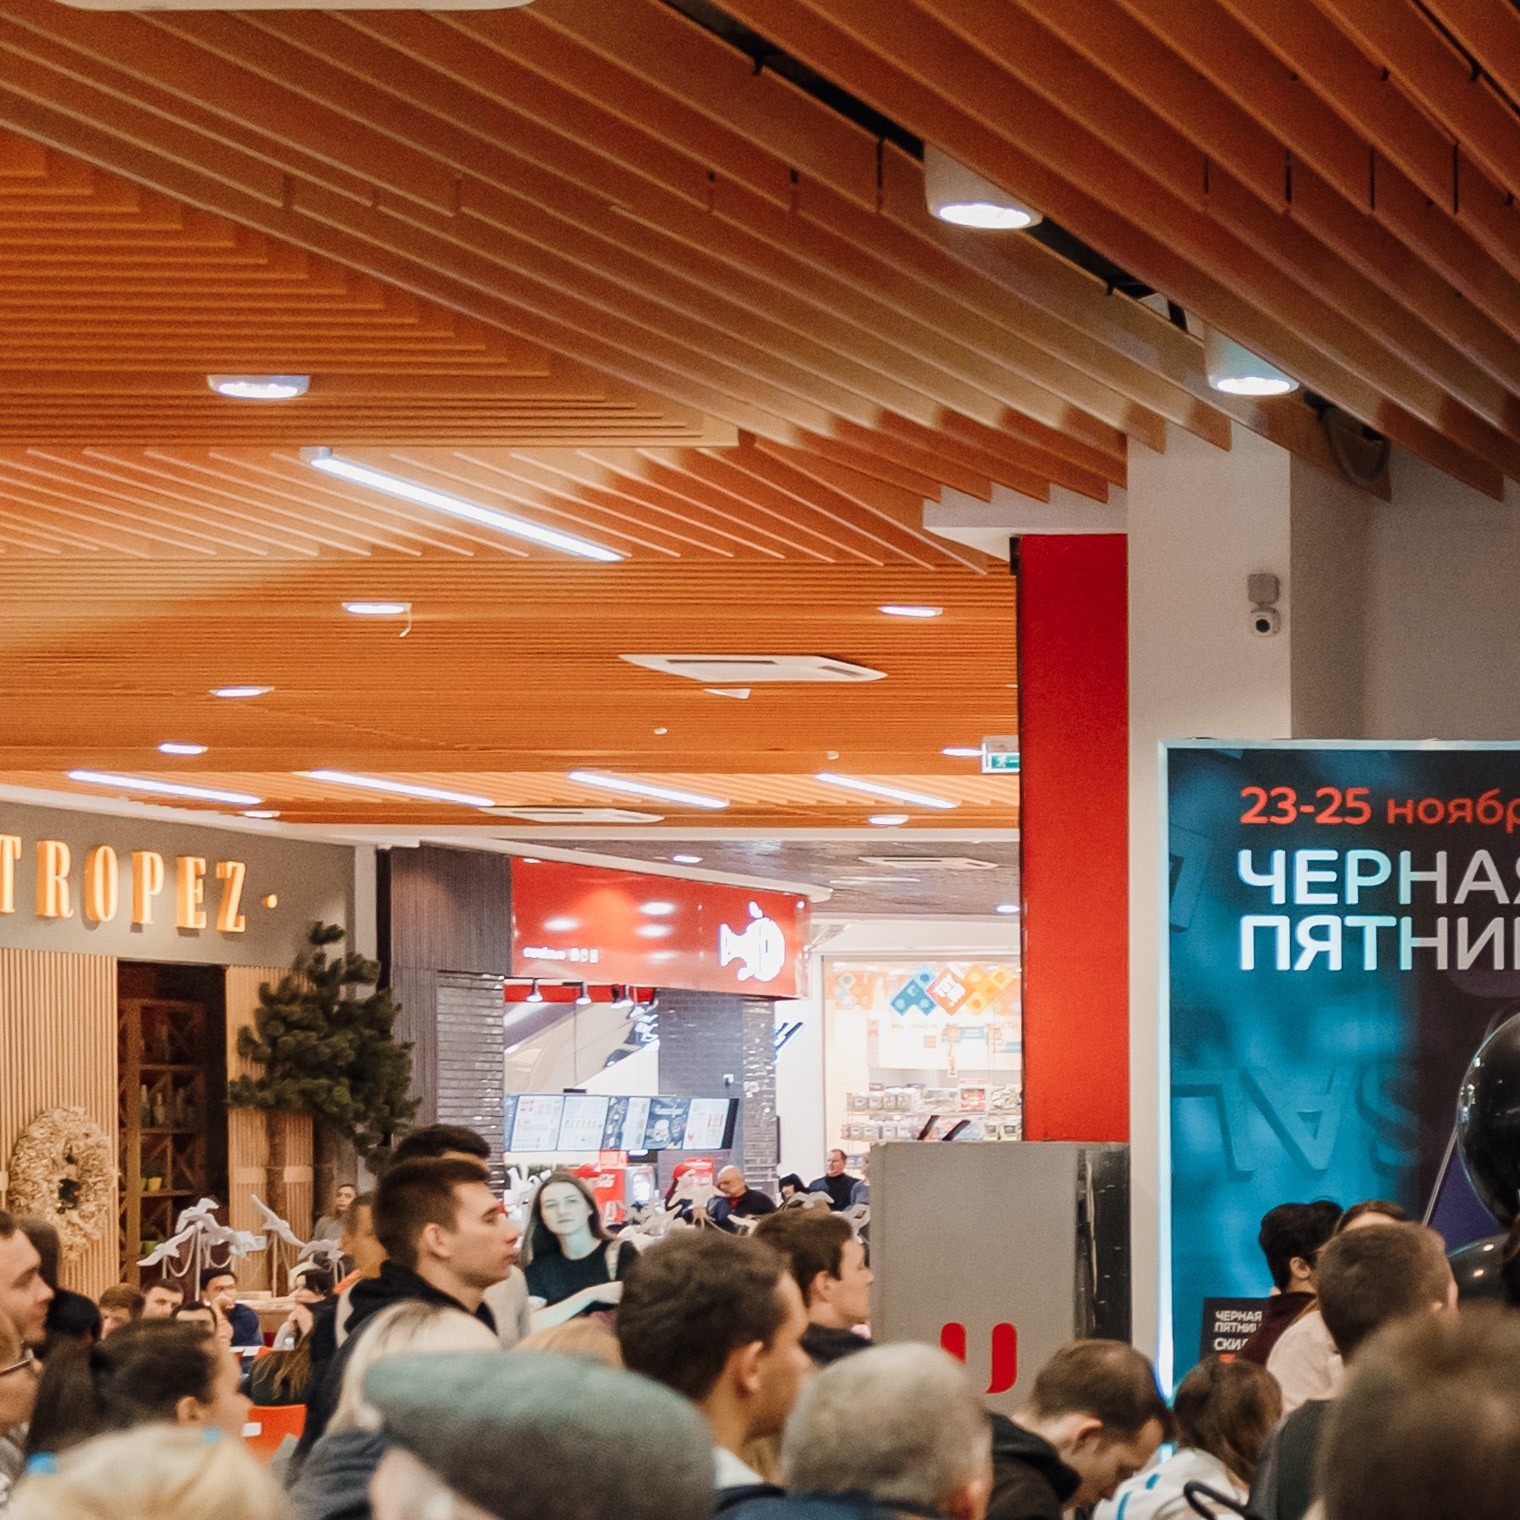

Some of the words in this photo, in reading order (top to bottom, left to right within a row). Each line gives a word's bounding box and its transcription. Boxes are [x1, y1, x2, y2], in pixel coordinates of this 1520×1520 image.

[1240, 787, 1373, 825] 23-25
[1215, 1310, 1262, 1322] ЧЕРНАЯ
[1214, 1321, 1261, 1333] ПЯТНИ
